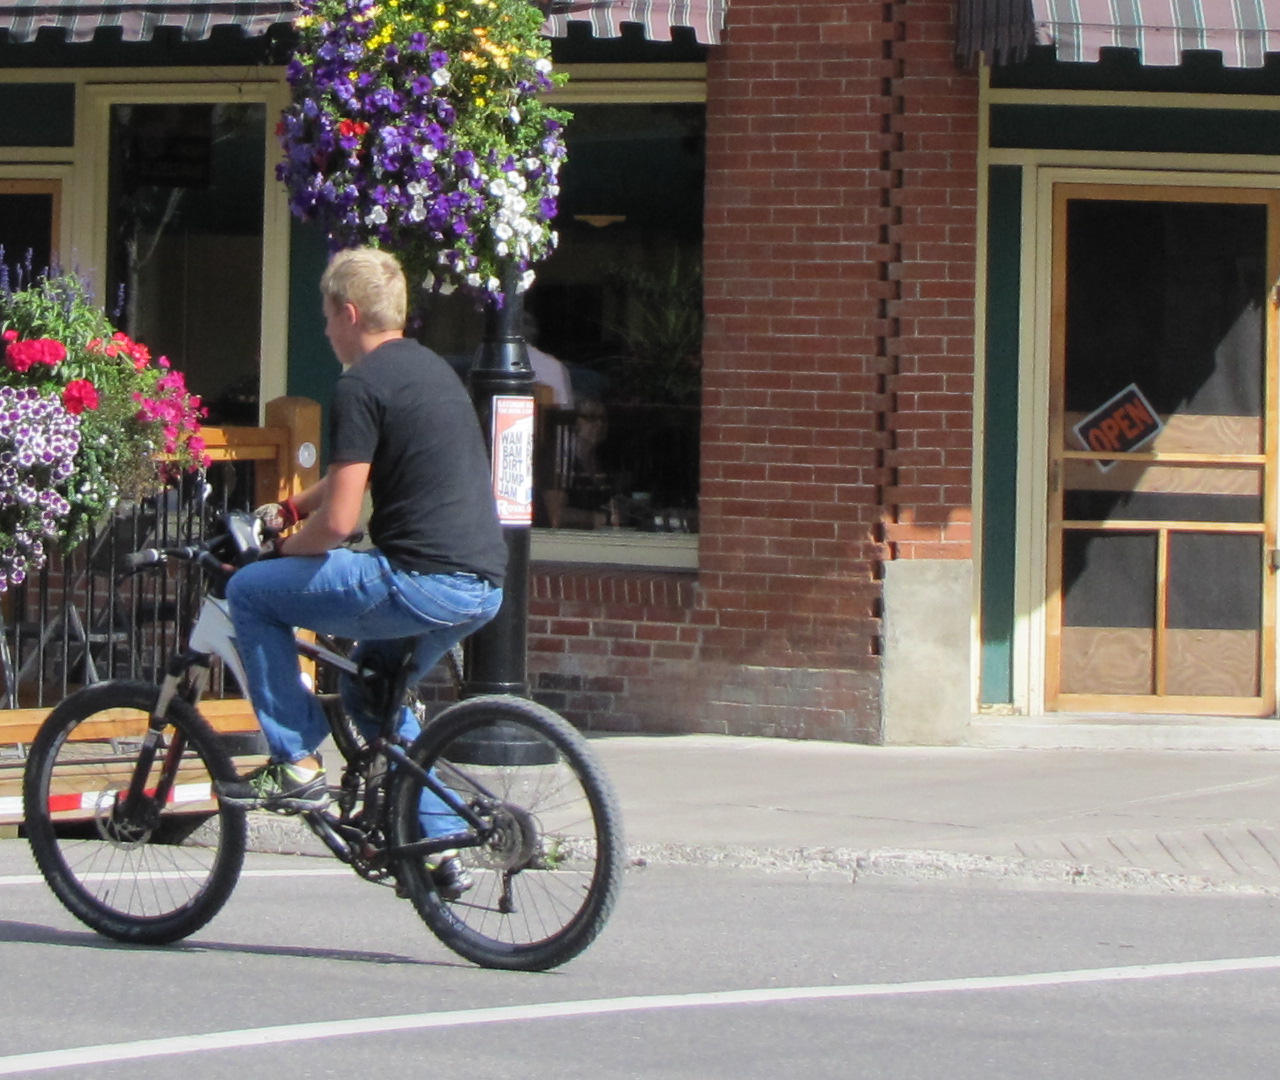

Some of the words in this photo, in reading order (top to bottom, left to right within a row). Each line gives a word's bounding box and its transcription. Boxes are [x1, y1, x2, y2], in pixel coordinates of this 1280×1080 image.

[1088, 396, 1155, 453] OPEN
[501, 431, 523, 446] WAM
[502, 445, 523, 459] BAM
[502, 458, 523, 473] DIRT
[499, 472, 525, 487] JUMP
[498, 486, 518, 500] JAM
